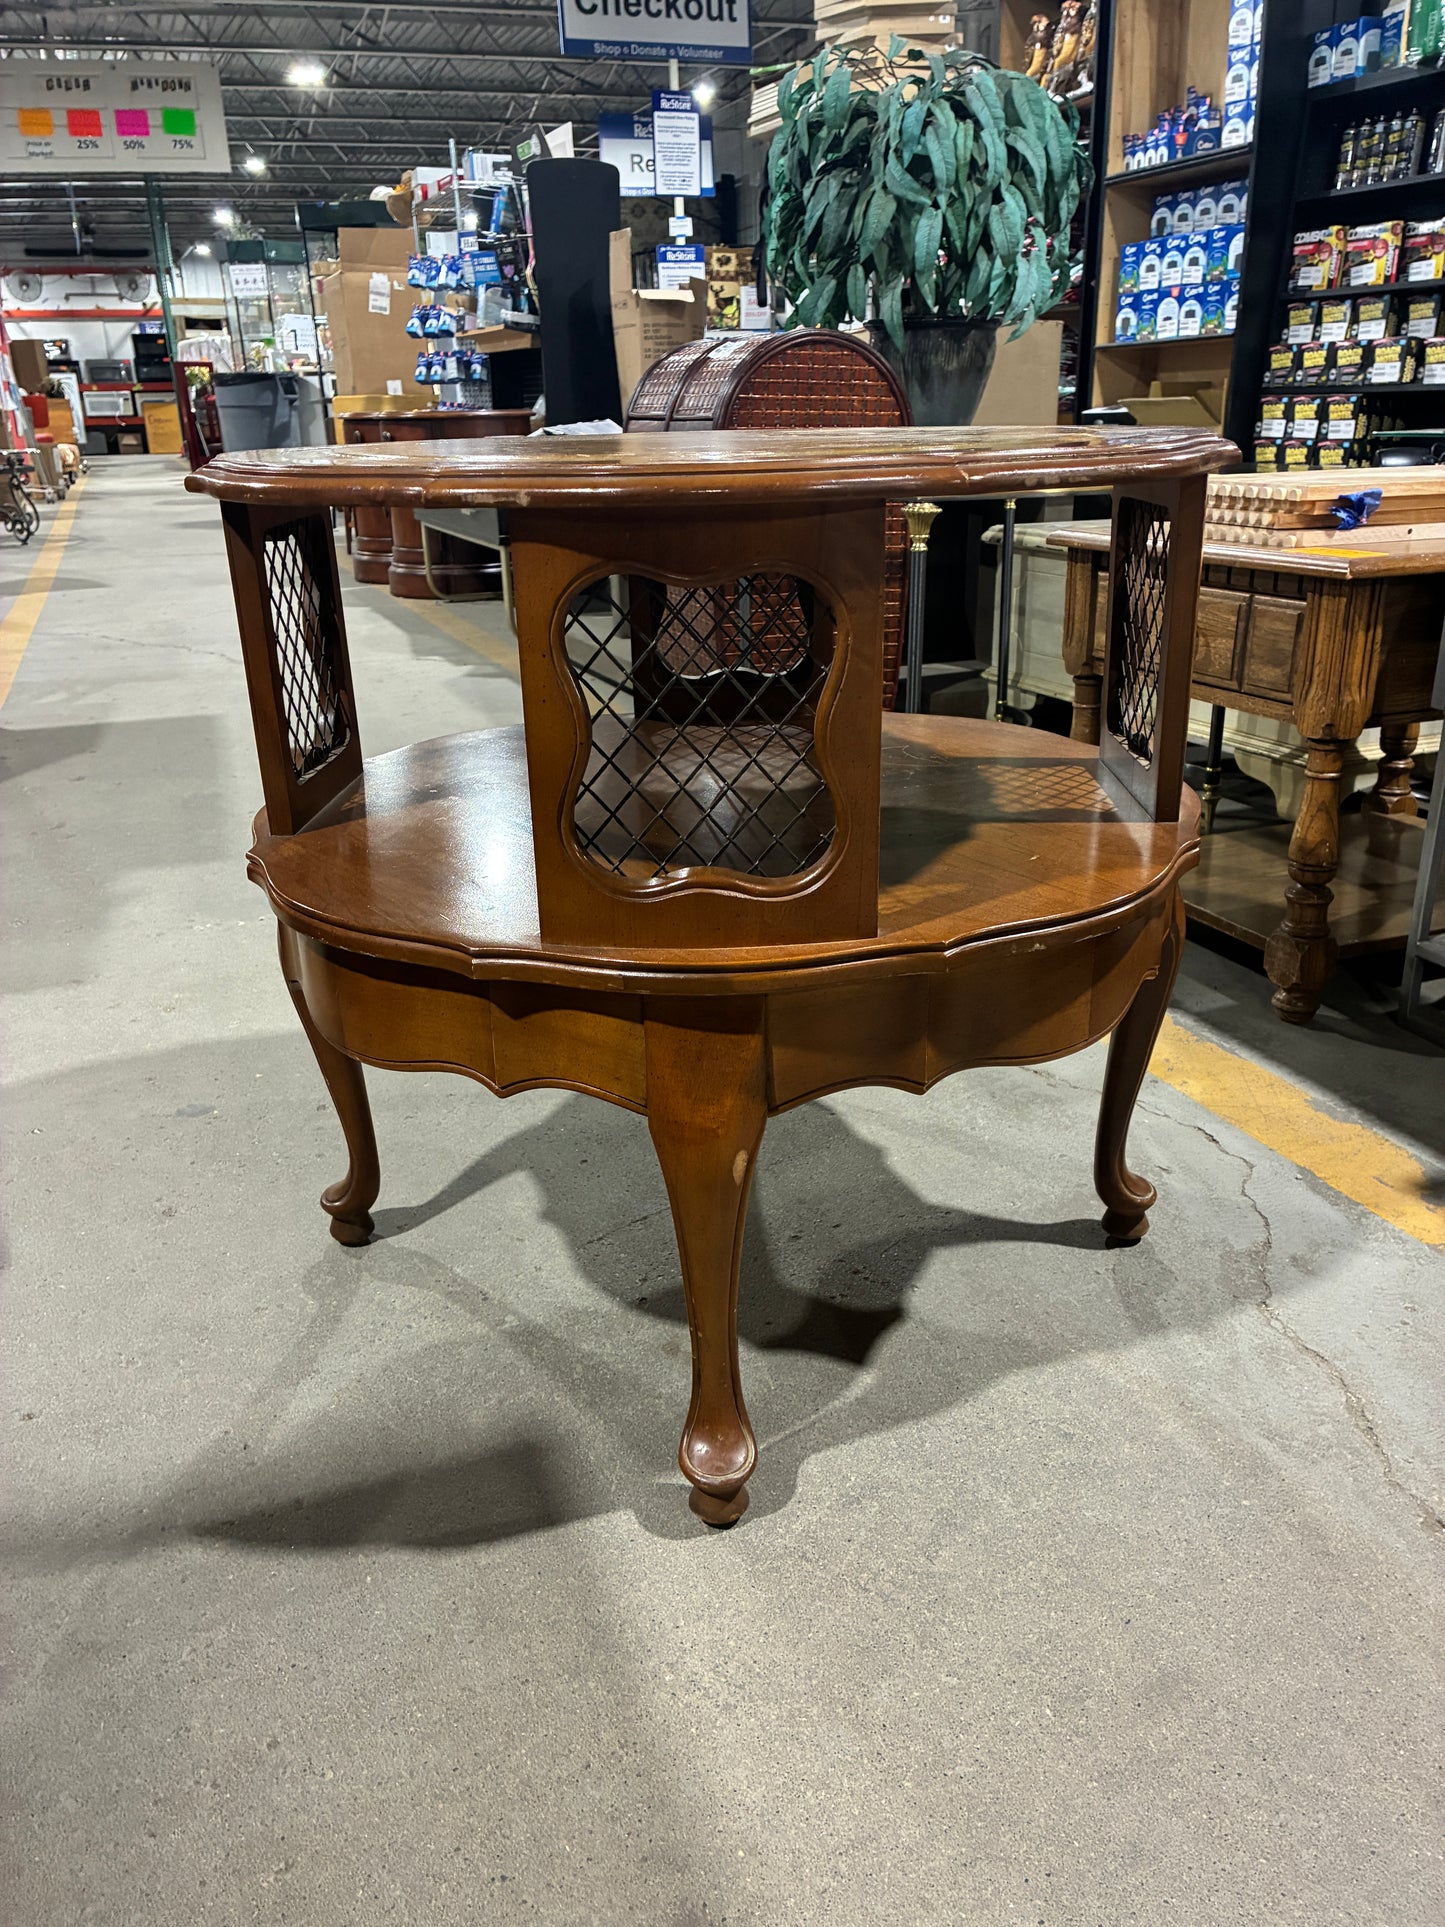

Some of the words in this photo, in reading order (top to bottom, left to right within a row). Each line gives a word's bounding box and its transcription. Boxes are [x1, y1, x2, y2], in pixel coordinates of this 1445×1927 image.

[576, 0, 737, 22] Checkout
[594, 42, 621, 56] Shop
[631, 44, 667, 57] Donate
[677, 47, 724, 59] Volunteer
[77, 139, 100, 149] 25%
[123, 139, 146, 150] 50%
[171, 139, 194, 150] 75%
